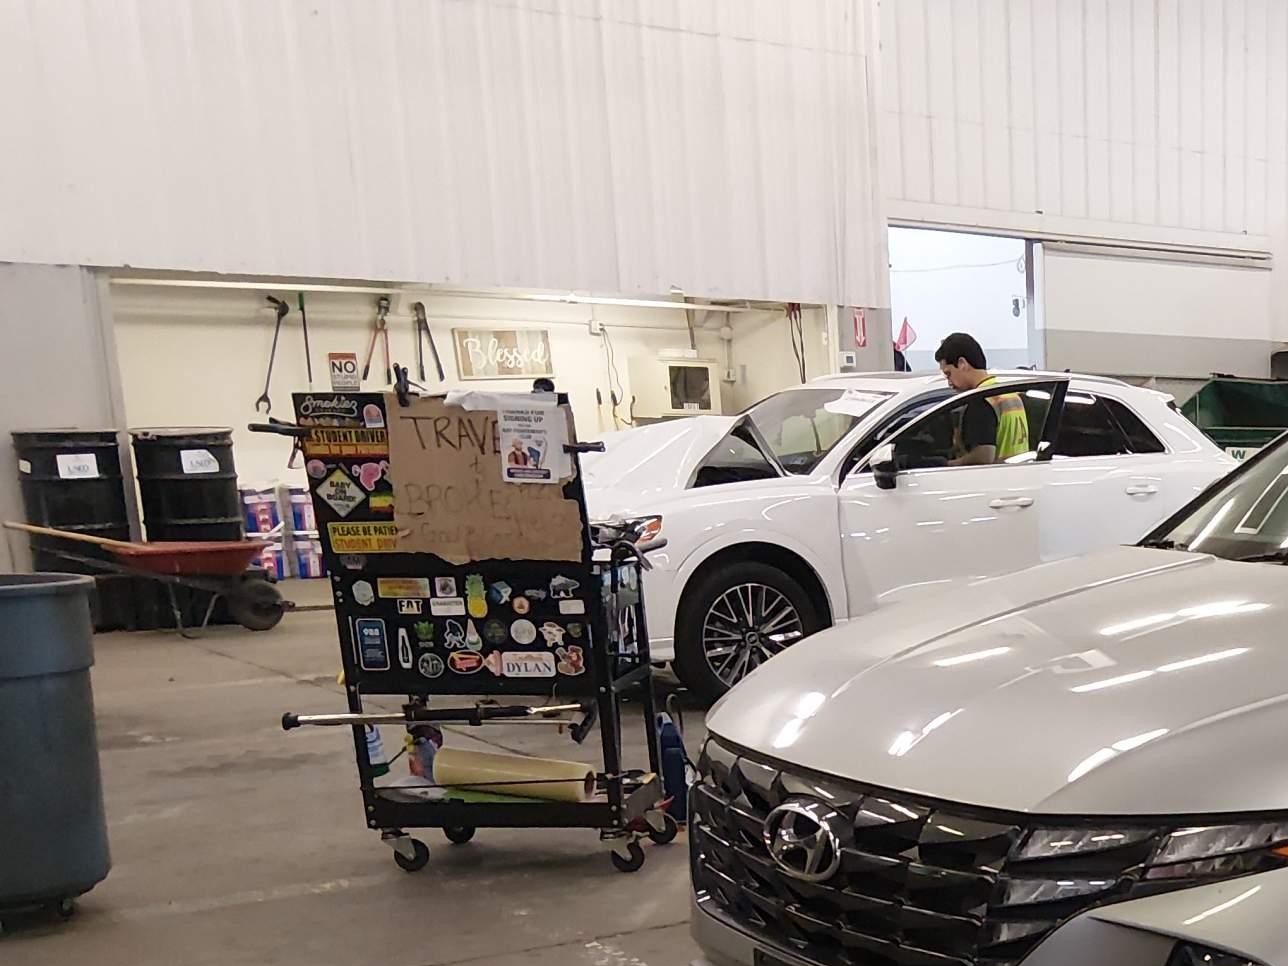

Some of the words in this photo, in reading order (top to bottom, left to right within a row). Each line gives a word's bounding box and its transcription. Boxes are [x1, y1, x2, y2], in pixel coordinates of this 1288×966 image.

[463, 337, 550, 369] Blessed
[331, 360, 356, 374] NO
[314, 429, 352, 443] STUDENT
[354, 430, 386, 443] DRIVER
[329, 480, 351, 489] BABY
[332, 526, 359, 537] PLEASE
[362, 527, 372, 537] BE
[335, 538, 372, 549] STUDENT
[399, 600, 422, 612] FAT
[506, 662, 552, 673] DYLAN
